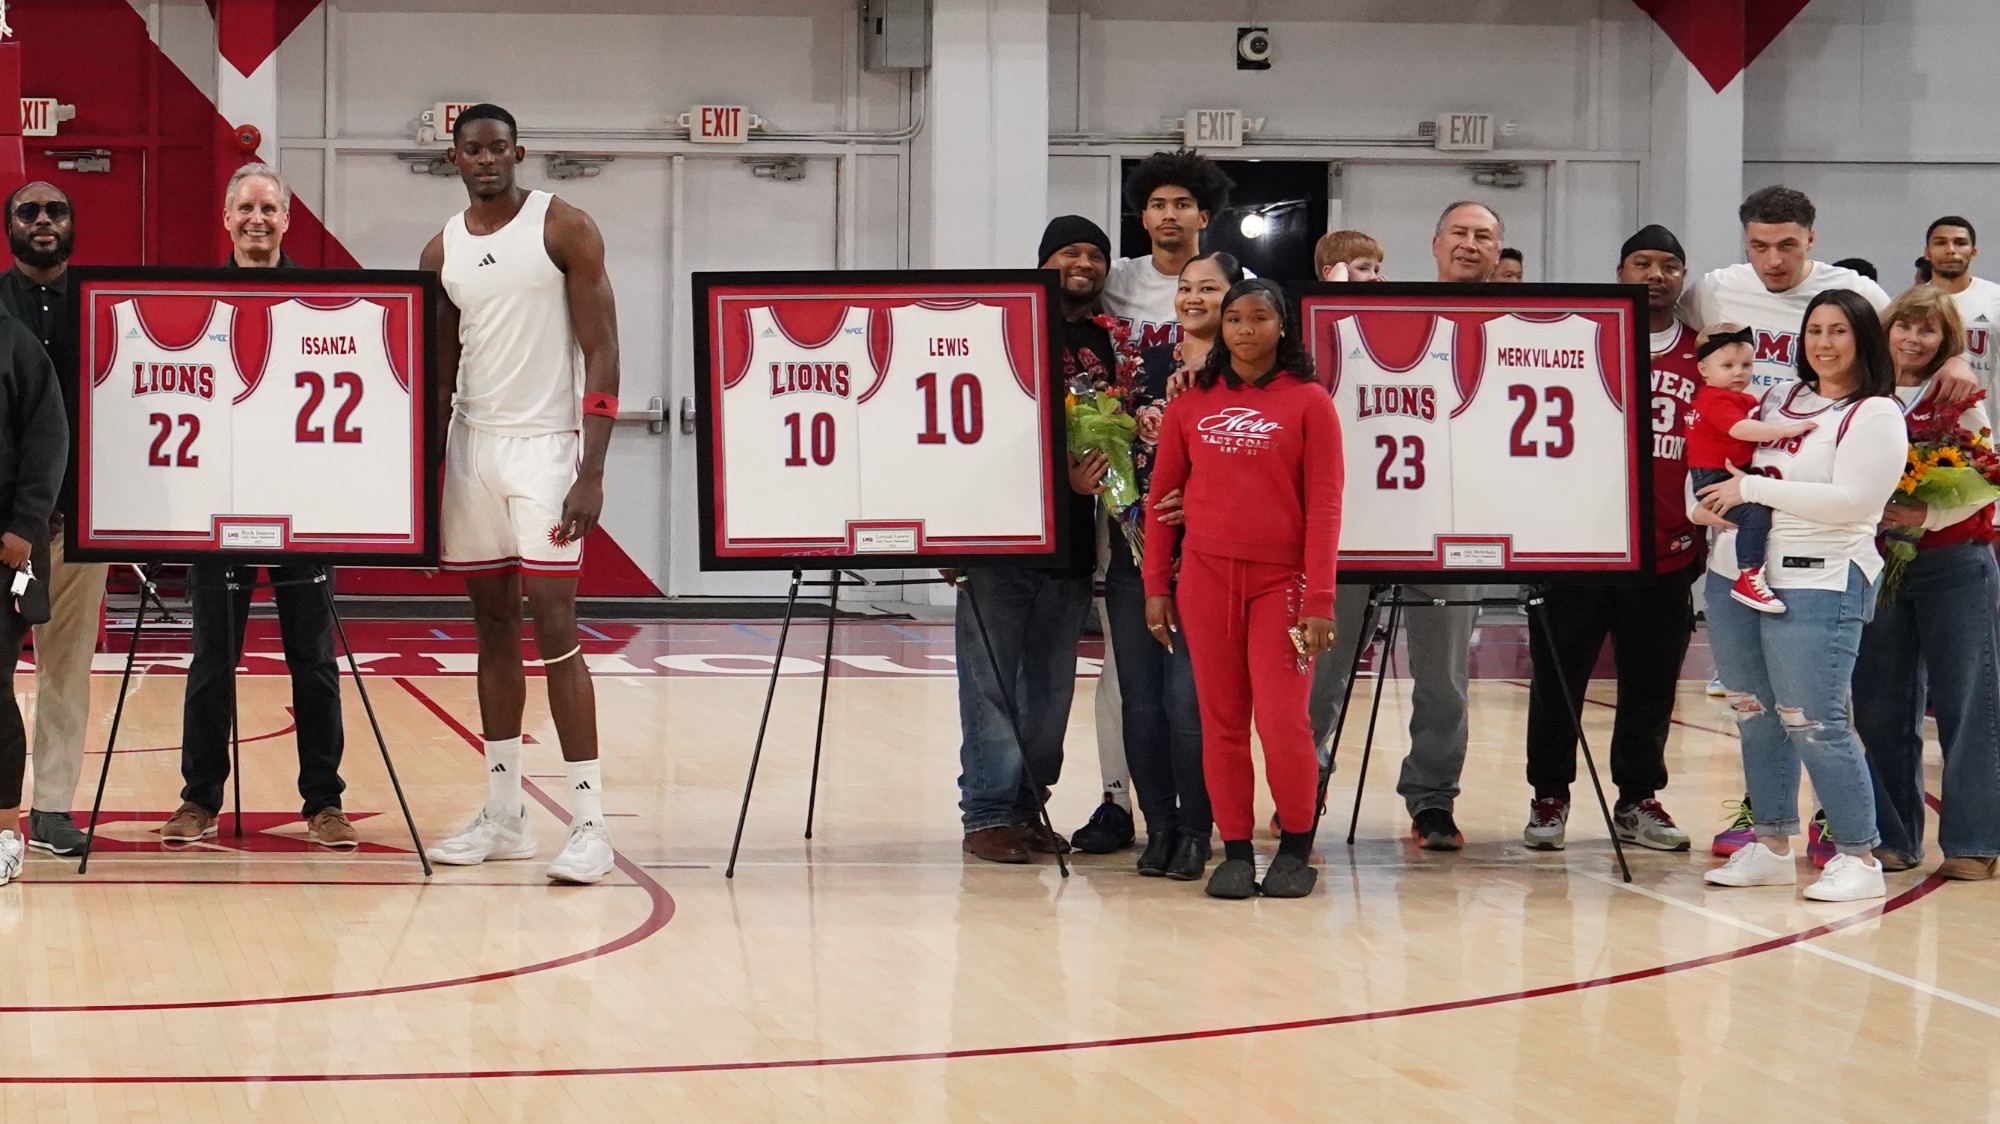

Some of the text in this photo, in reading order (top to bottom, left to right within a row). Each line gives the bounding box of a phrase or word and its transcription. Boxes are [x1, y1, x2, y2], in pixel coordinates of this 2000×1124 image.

[22, 100, 50, 130] XIT
[701, 107, 742, 137] EXIT
[1196, 111, 1236, 141] EXIT
[1449, 115, 1489, 145] EXIT
[301, 335, 358, 355] ISSANZA
[928, 337, 970, 357] LEWIS
[1497, 347, 1585, 369] MERKVILADZE
[132, 362, 216, 402] LIONS
[769, 361, 852, 400] LIONS
[294, 370, 365, 444] 22
[915, 371, 984, 446] 10
[1197, 406, 1284, 433] Aero
[1356, 384, 1438, 424] LIONS
[1507, 383, 1575, 459] 23
[1651, 396, 1677, 433] 3
[148, 412, 201, 468] 22
[784, 411, 836, 468] 10
[1374, 433, 1426, 491] 23
